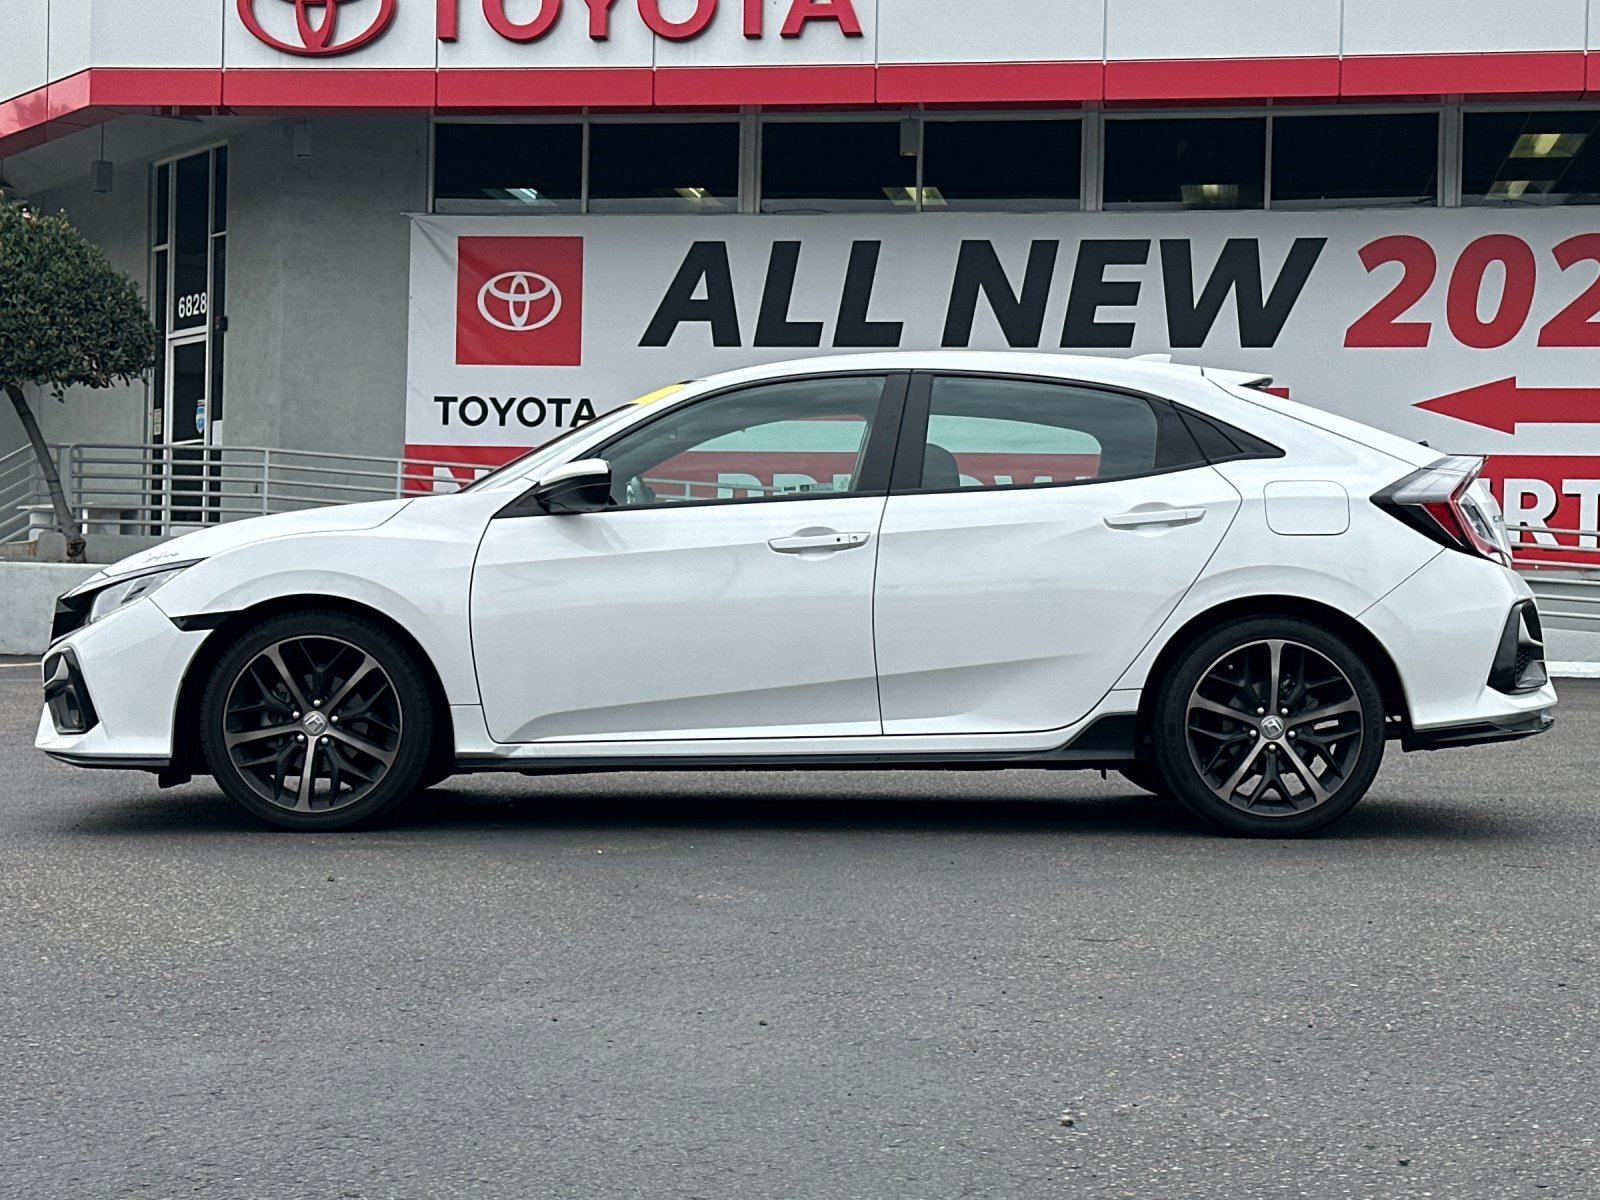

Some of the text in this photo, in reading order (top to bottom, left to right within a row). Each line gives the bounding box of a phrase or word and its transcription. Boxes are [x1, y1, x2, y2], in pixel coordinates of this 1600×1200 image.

[178, 292, 207, 319] 6828
[638, 233, 1600, 349] ALL NEW 202
[433, 395, 598, 428] TOYOTA
